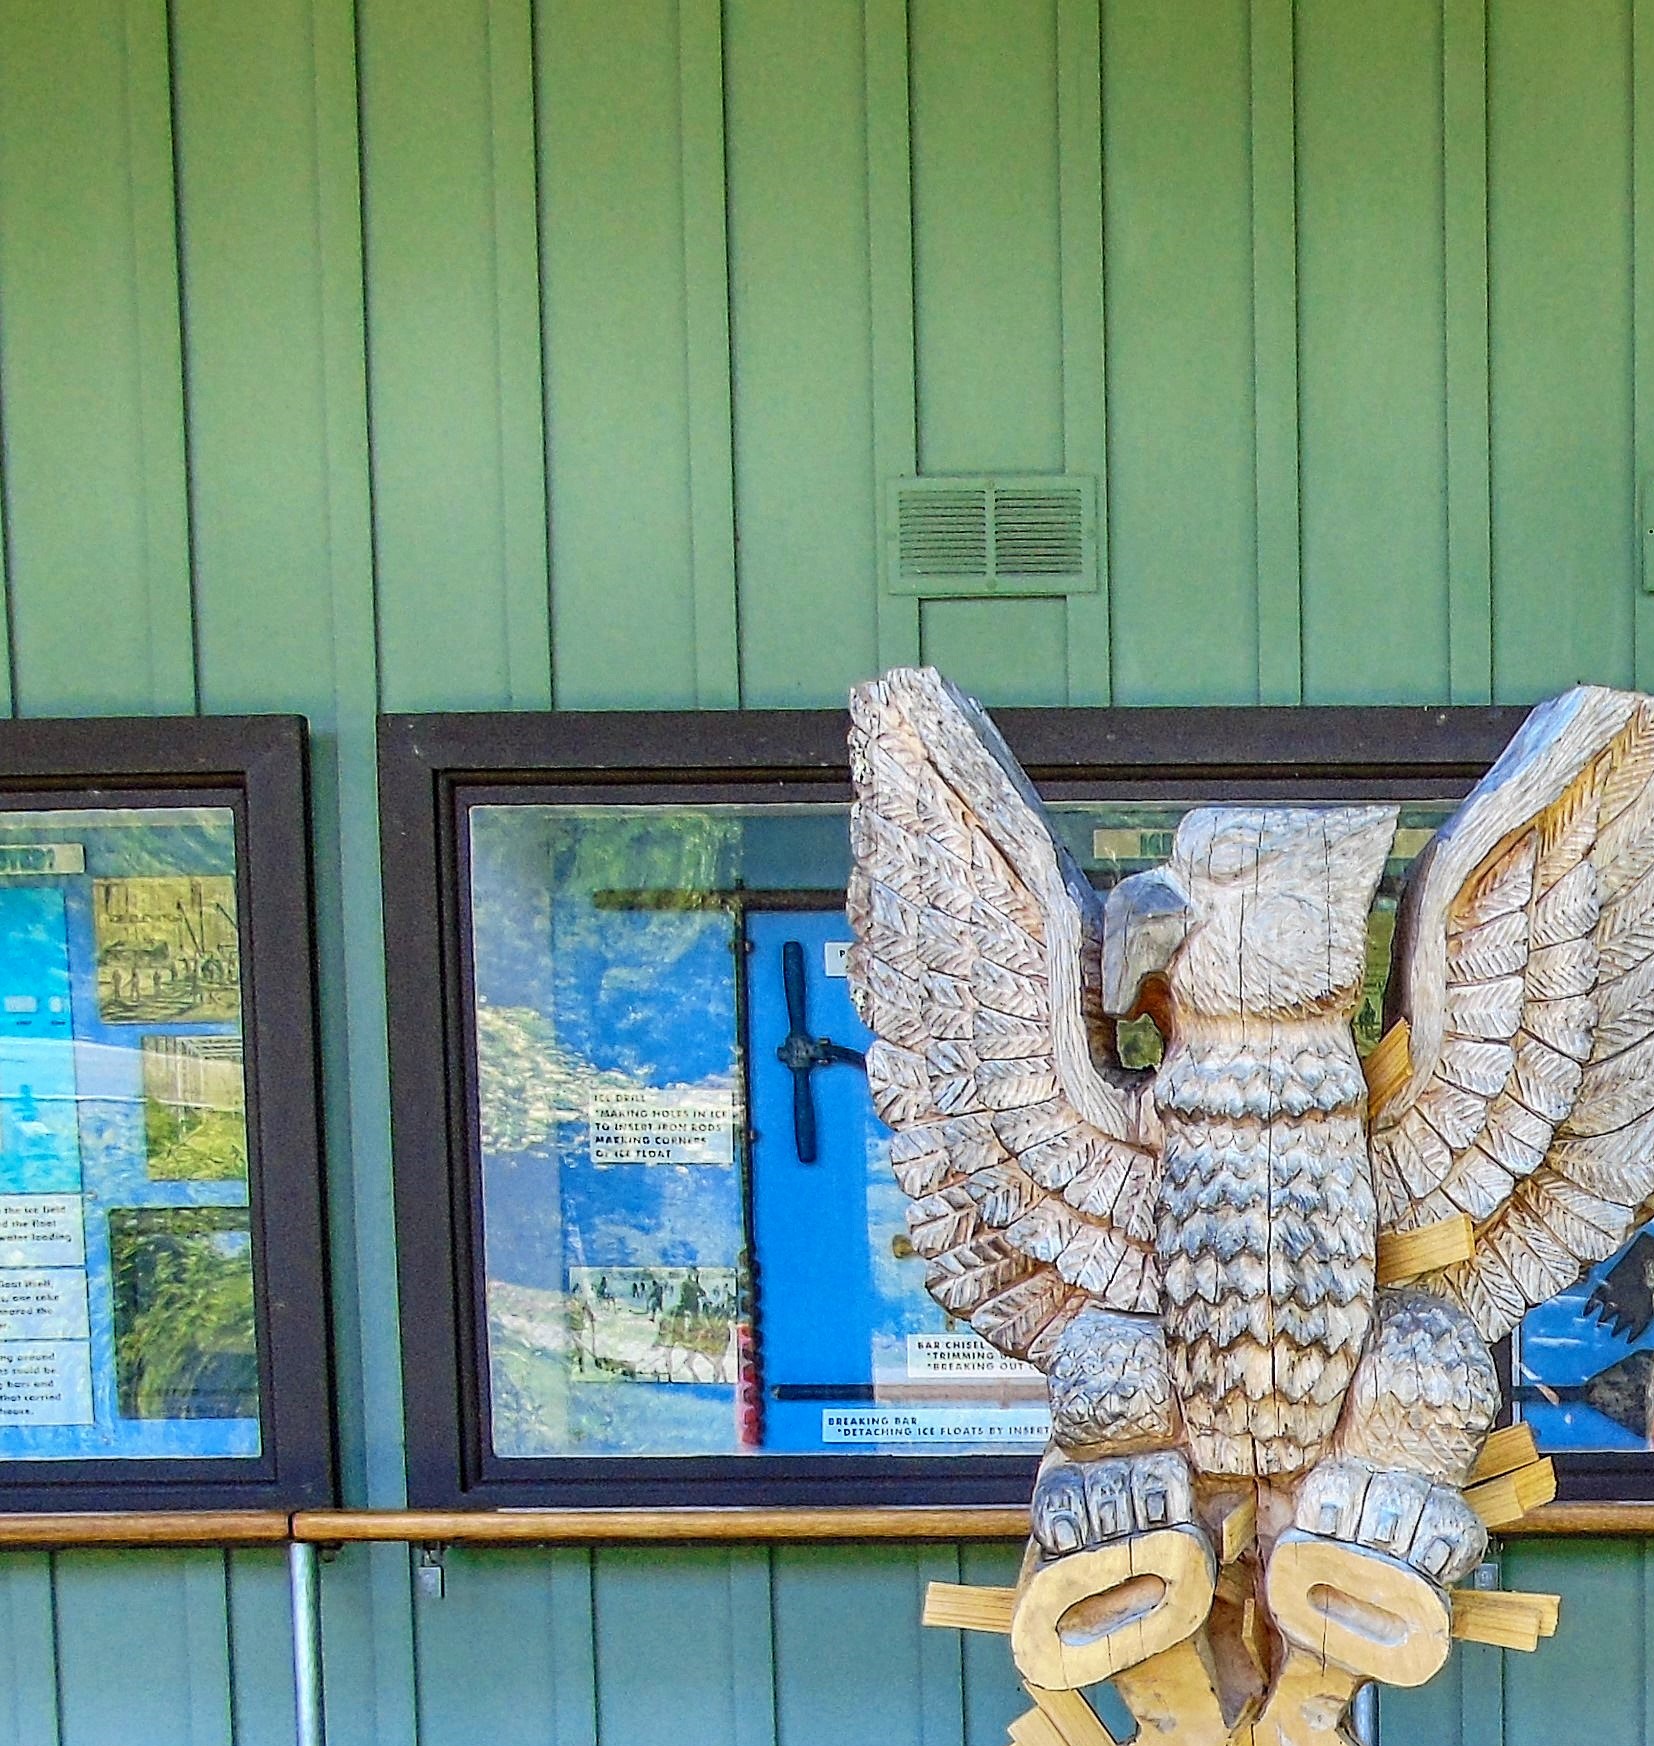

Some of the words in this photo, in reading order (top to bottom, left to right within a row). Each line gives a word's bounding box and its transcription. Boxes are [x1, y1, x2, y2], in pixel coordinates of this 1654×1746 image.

[652, 1109, 689, 1119] HOLES
[693, 1110, 706, 1119] IN
[594, 1122, 610, 1131] TO
[614, 1123, 653, 1132] INSERT
[917, 1341, 940, 1349] BAR
[945, 1341, 985, 1350] CHISEL
[999, 1362, 1024, 1371] OUT
[828, 1416, 889, 1426] BREAKING
[894, 1416, 918, 1426] BAR
[917, 1427, 935, 1436] ICE
[940, 1427, 984, 1436] FLOATS
[989, 1427, 1003, 1436] BY
